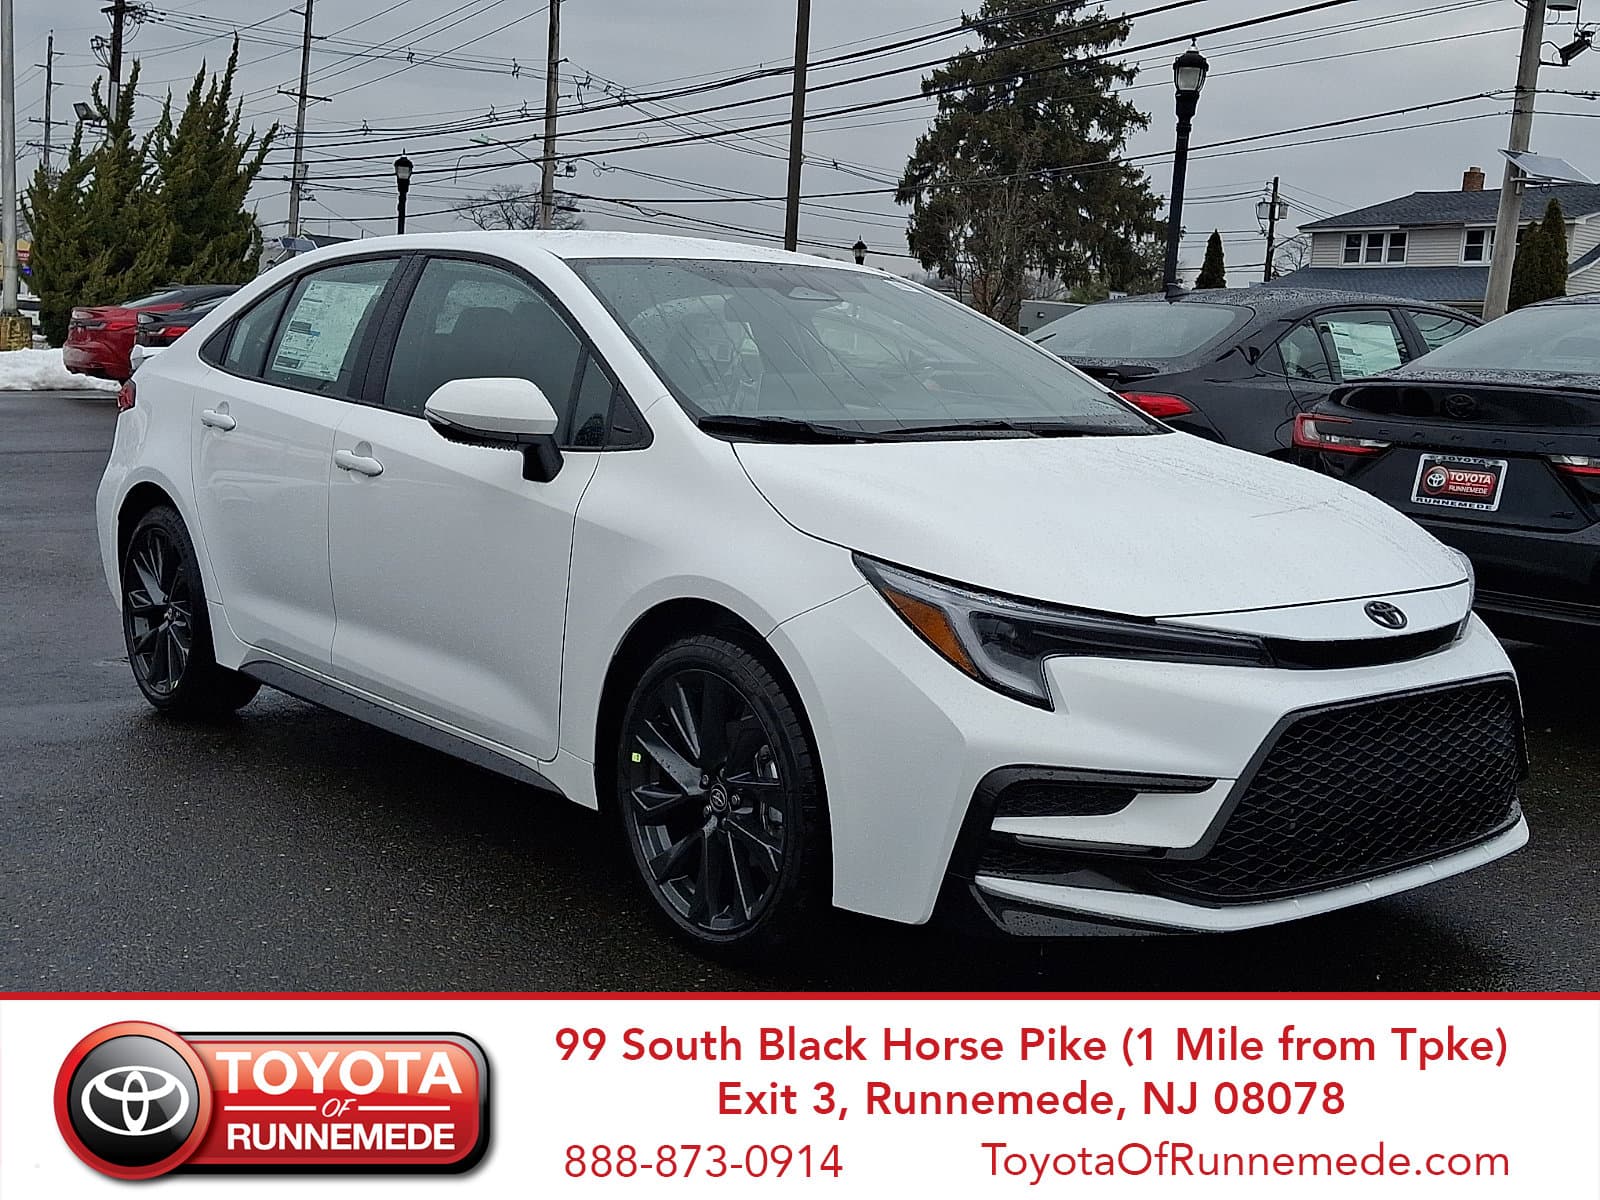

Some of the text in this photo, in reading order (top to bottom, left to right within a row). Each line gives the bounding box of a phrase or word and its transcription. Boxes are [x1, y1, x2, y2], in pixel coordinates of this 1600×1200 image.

[1442, 455, 1486, 465] TOYOTA
[1449, 472, 1491, 484] TOYOTA
[1448, 485, 1489, 495] RUNNEMEDE
[1415, 497, 1493, 510] RUNNEMEDE
